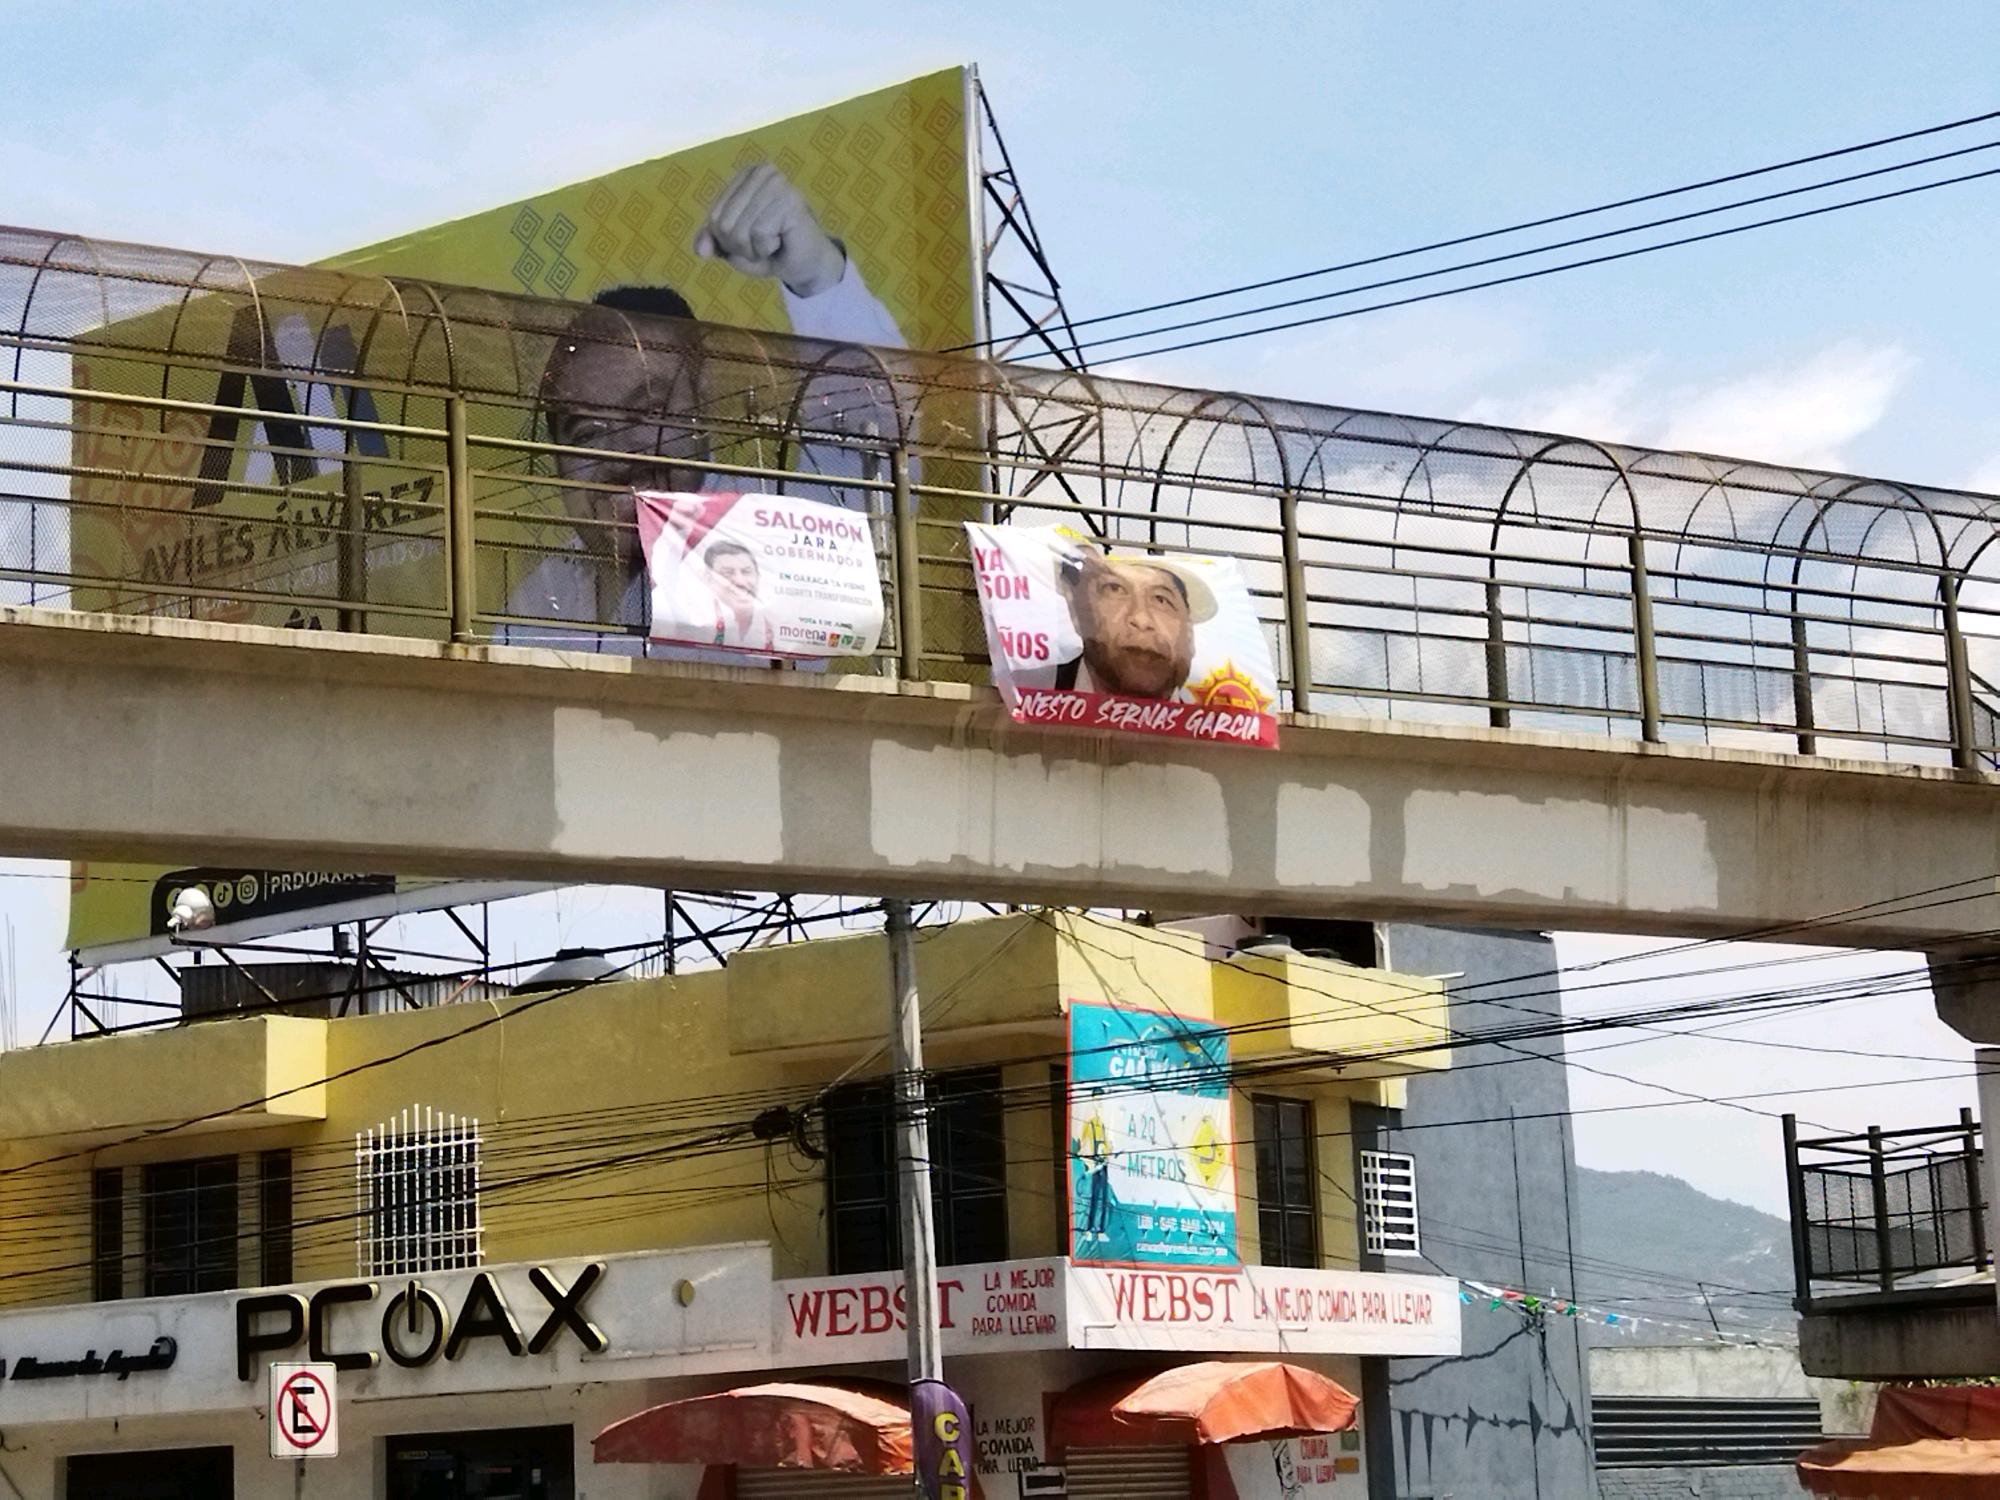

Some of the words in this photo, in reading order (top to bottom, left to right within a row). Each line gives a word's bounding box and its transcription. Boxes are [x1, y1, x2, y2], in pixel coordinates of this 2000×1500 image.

[267, 476, 434, 558] ÁLVREZ
[754, 509, 864, 543] SALOMÓN
[791, 533, 838, 550] JARA
[763, 544, 863, 568] GOBERNADOR
[975, 547, 1004, 571] YA
[981, 575, 1030, 601] SON
[780, 625, 827, 641] morena
[1094, 698, 1183, 731] SERNAS
[1184, 707, 1261, 741] GARCIA
[1128, 1114, 1137, 1137] A
[1128, 1153, 1186, 1182] METROS
[984, 1272, 1002, 1291] LA
[1010, 1267, 1055, 1290] MEJOR
[987, 1293, 1037, 1313] COMIDA
[1107, 1273, 1240, 1323] WEBST
[1253, 1290, 1269, 1320] LA
[1274, 1287, 1313, 1321] MEJOR
[1318, 1289, 1357, 1323] COMIDA
[1362, 1291, 1388, 1323] PARA
[1391, 1293, 1433, 1325] LLEVAR
[237, 1262, 609, 1382] PCOAX
[972, 1317, 1002, 1336] PARA
[1009, 1314, 1057, 1336] LLEVAR
[292, 1386, 321, 1434] E
[976, 1421, 990, 1436] LA
[995, 1417, 1036, 1434] MEJOR
[979, 1437, 1034, 1456] COMIDA
